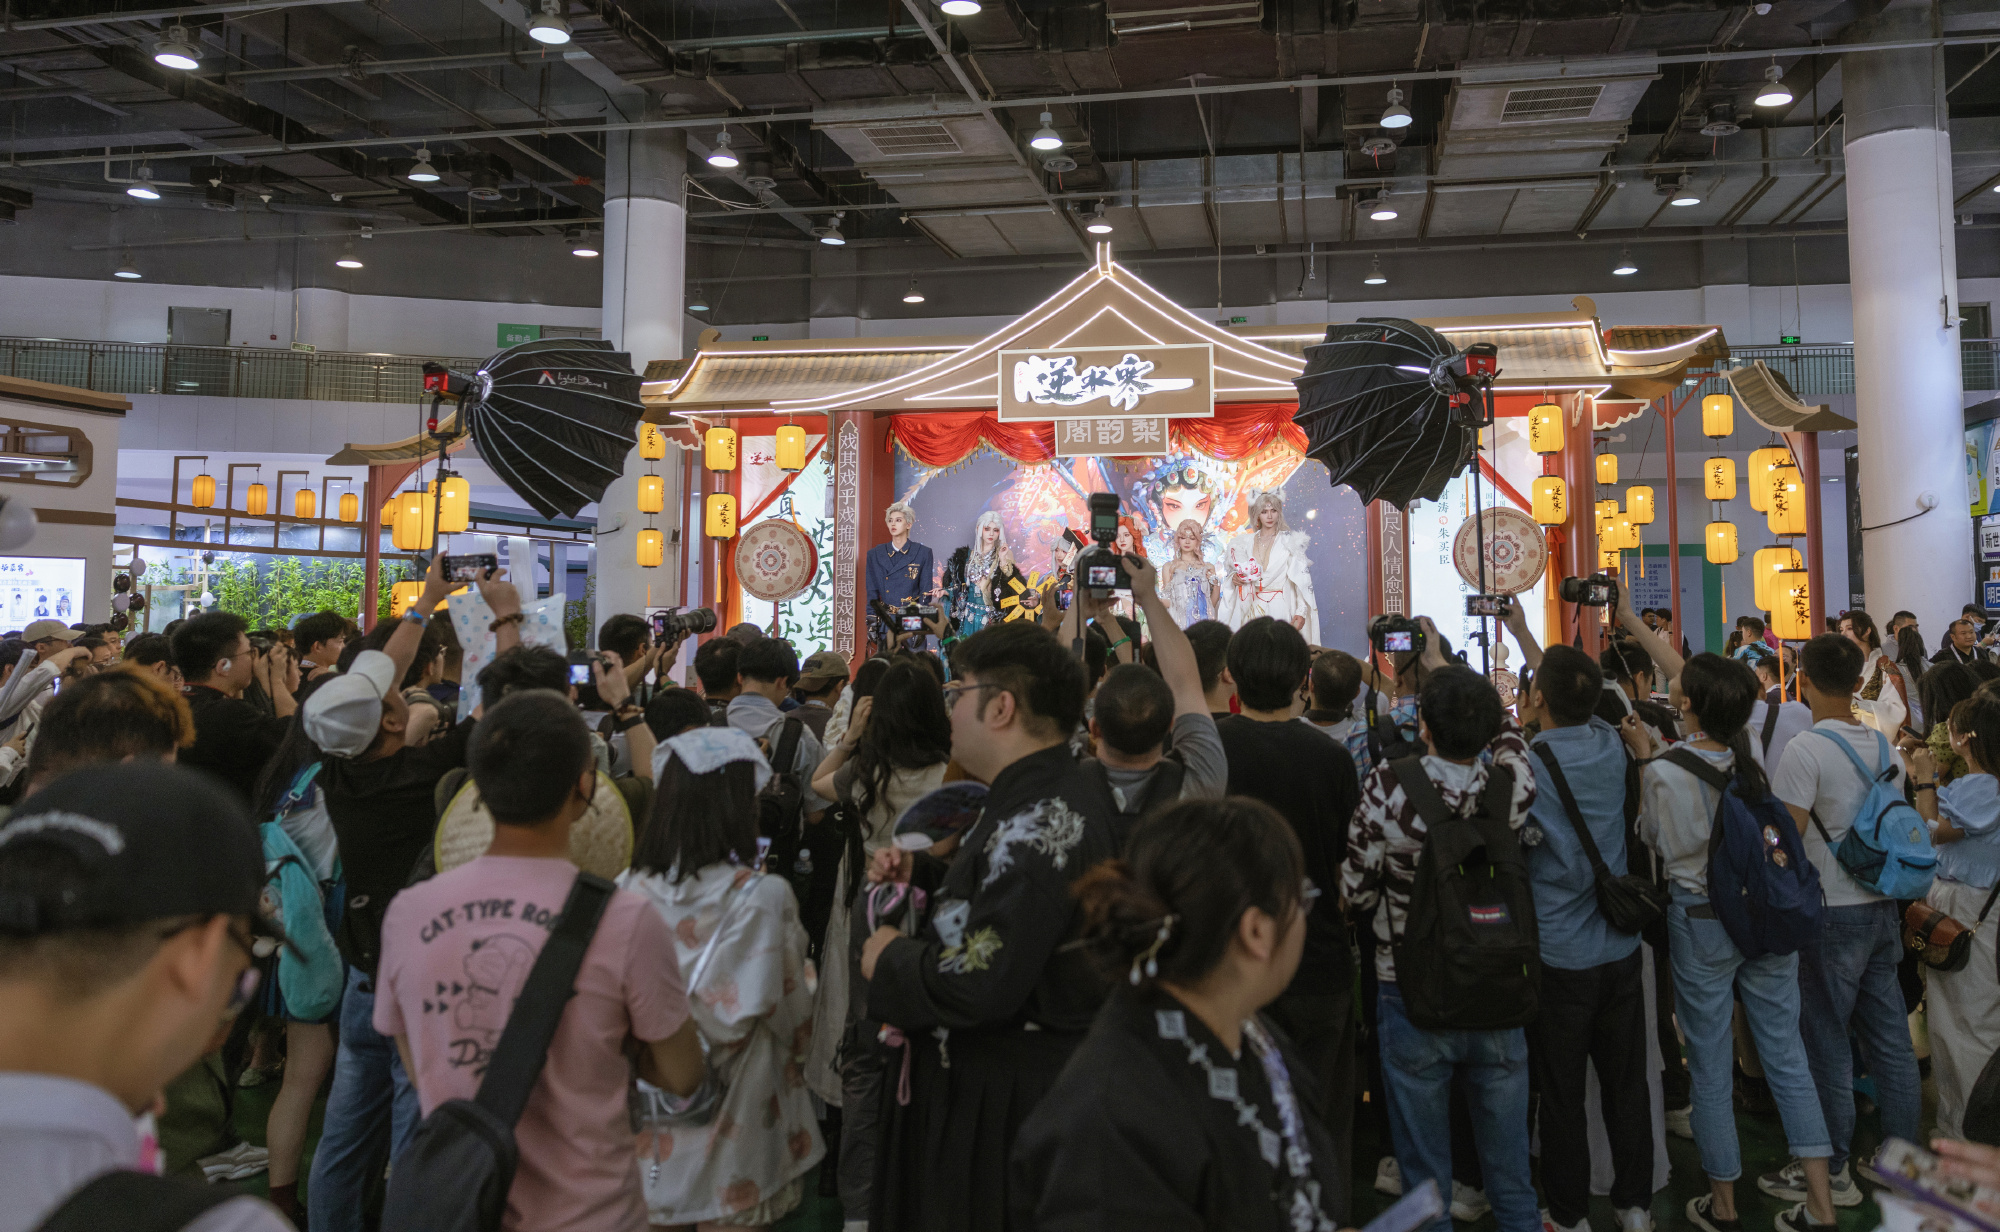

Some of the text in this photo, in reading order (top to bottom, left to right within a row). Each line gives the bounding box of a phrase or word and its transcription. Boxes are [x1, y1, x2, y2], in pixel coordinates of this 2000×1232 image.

[1033, 355, 1156, 405] 逆水寒
[749, 451, 776, 466] 逆水
[1772, 477, 1790, 518] 逆水寒
[1437, 527, 1450, 565] 朱买臣
[1792, 584, 1811, 625] 逆水寒
[520, 902, 557, 933] RO
